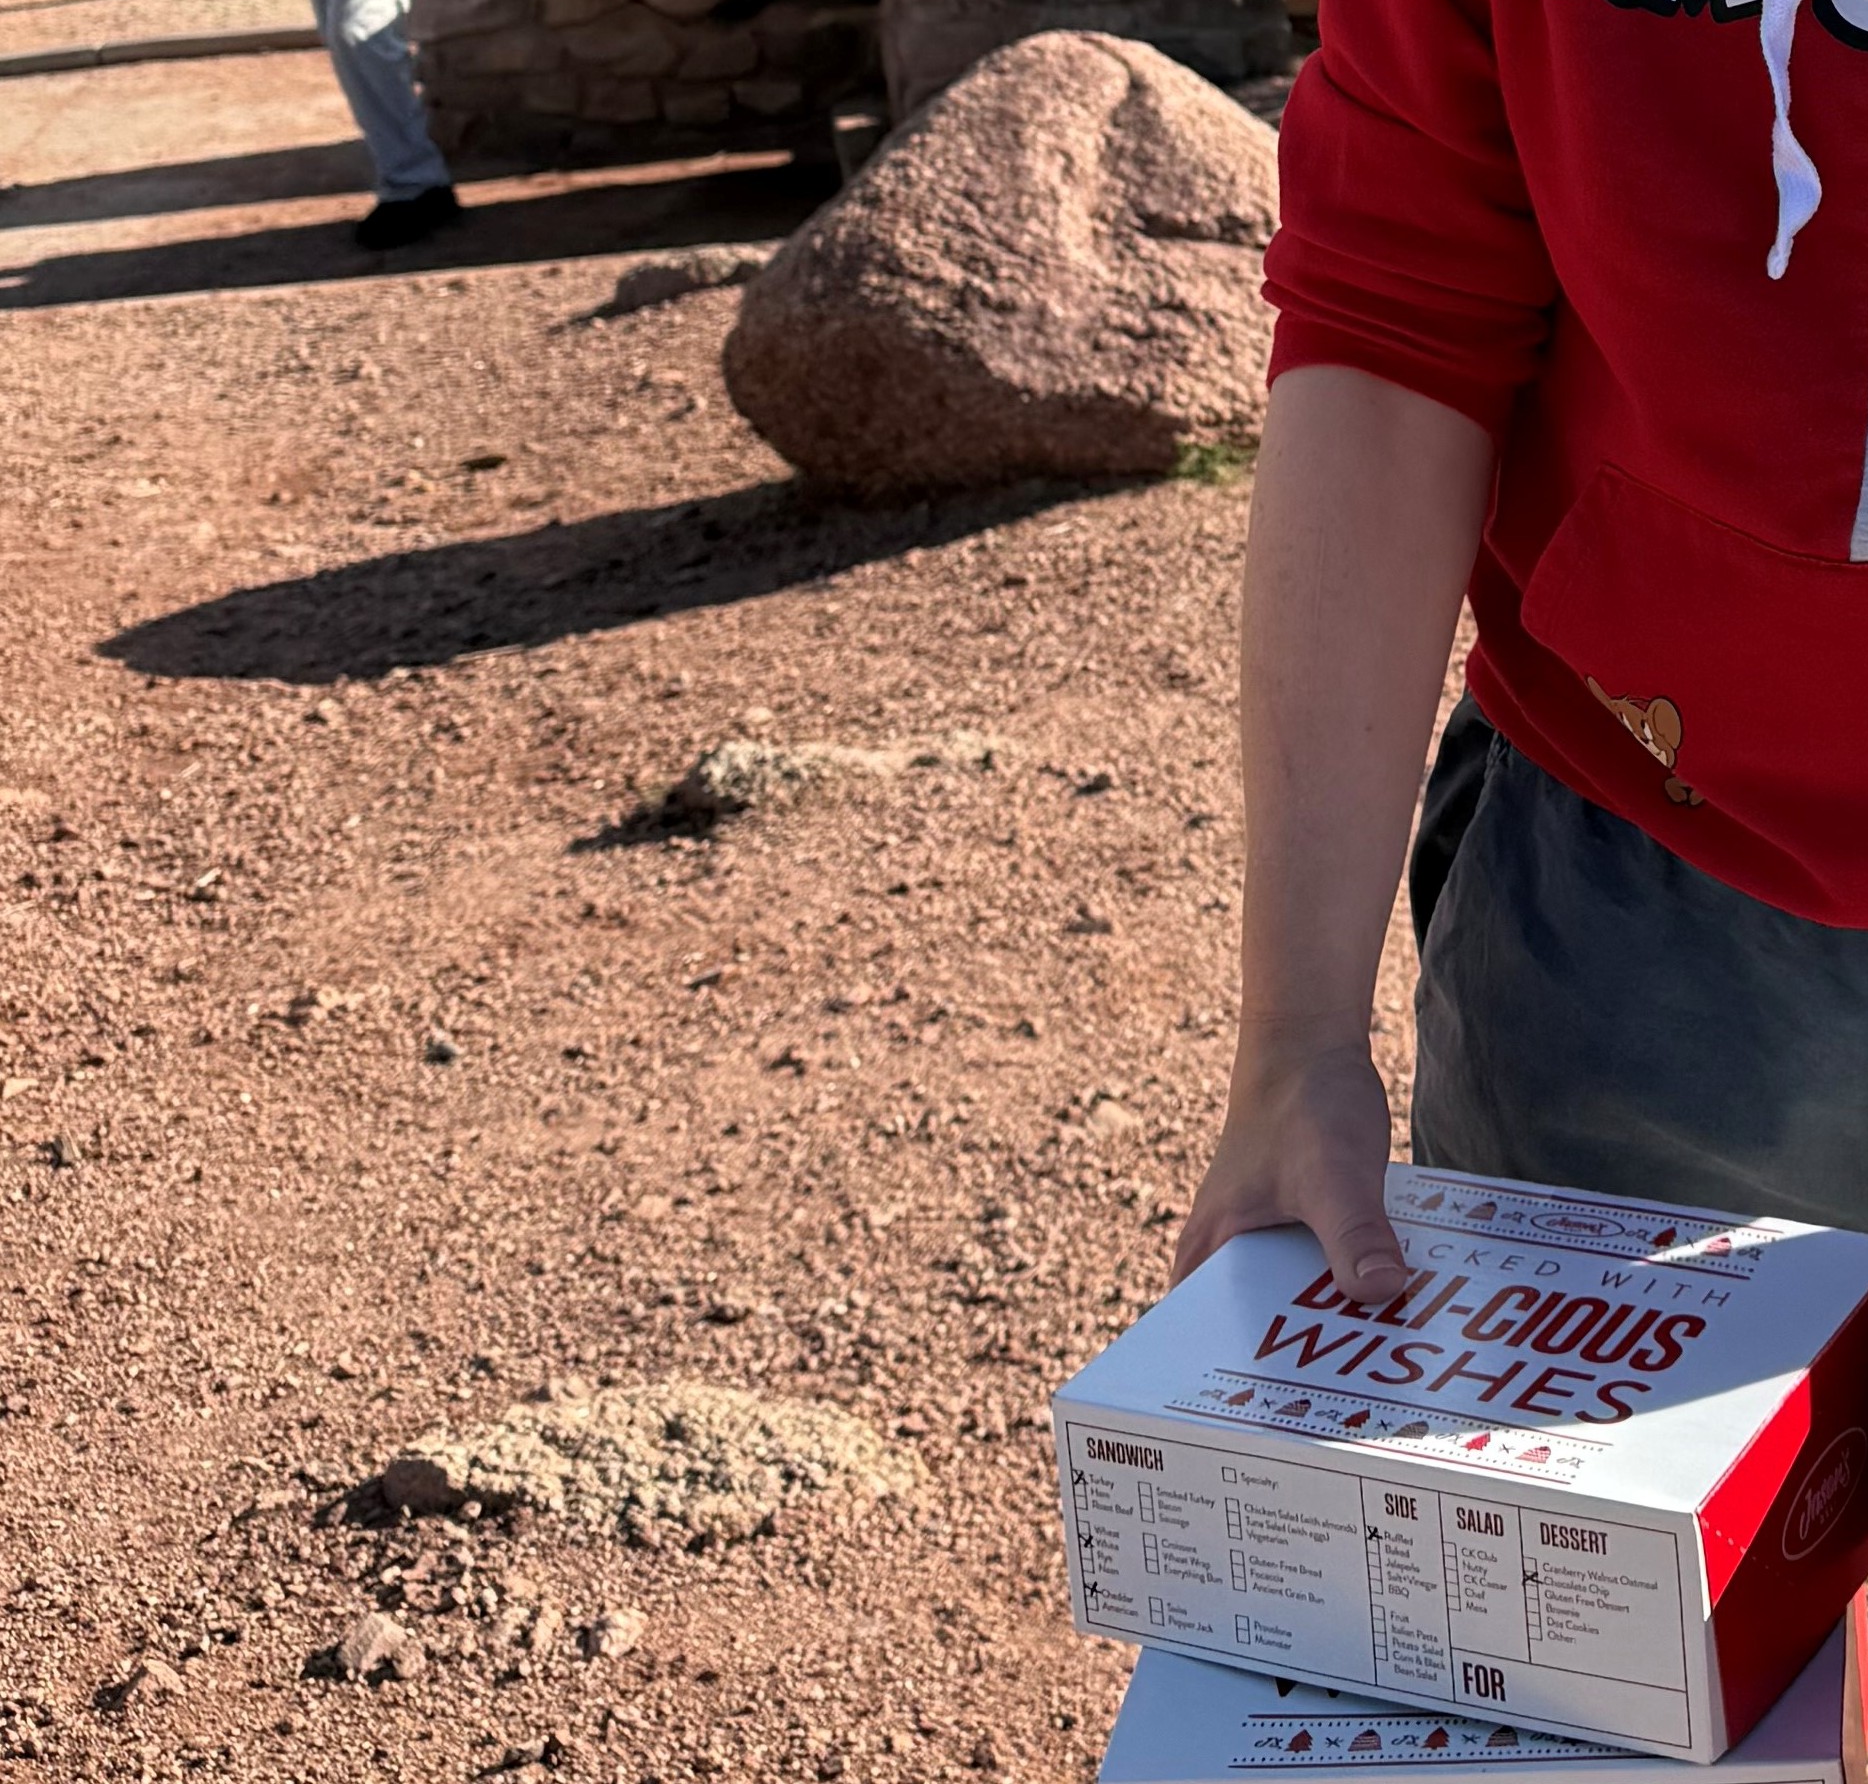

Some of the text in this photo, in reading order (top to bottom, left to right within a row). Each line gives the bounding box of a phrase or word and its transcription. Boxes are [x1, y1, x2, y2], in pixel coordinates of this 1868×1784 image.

[1401, 1236, 1732, 1307] CKED WITH
[1253, 1314, 1652, 1425] WISHES
[1087, 1437, 1164, 1471] SANDWICH
[1089, 1474, 1114, 1489] Turkey
[1157, 1487, 1215, 1509] Smoked Turkey
[1385, 1493, 1418, 1521] SIDE
[1245, 1504, 1277, 1517] Chicken
[1278, 1509, 1299, 1522] Salad
[1456, 1507, 1504, 1537] SALAD
[1540, 1522, 1608, 1555] DESSERT
[1543, 1562, 1586, 1581] Cranberry
[1388, 1585, 1410, 1599] BBQ
[1462, 1661, 1506, 1702] FOR
